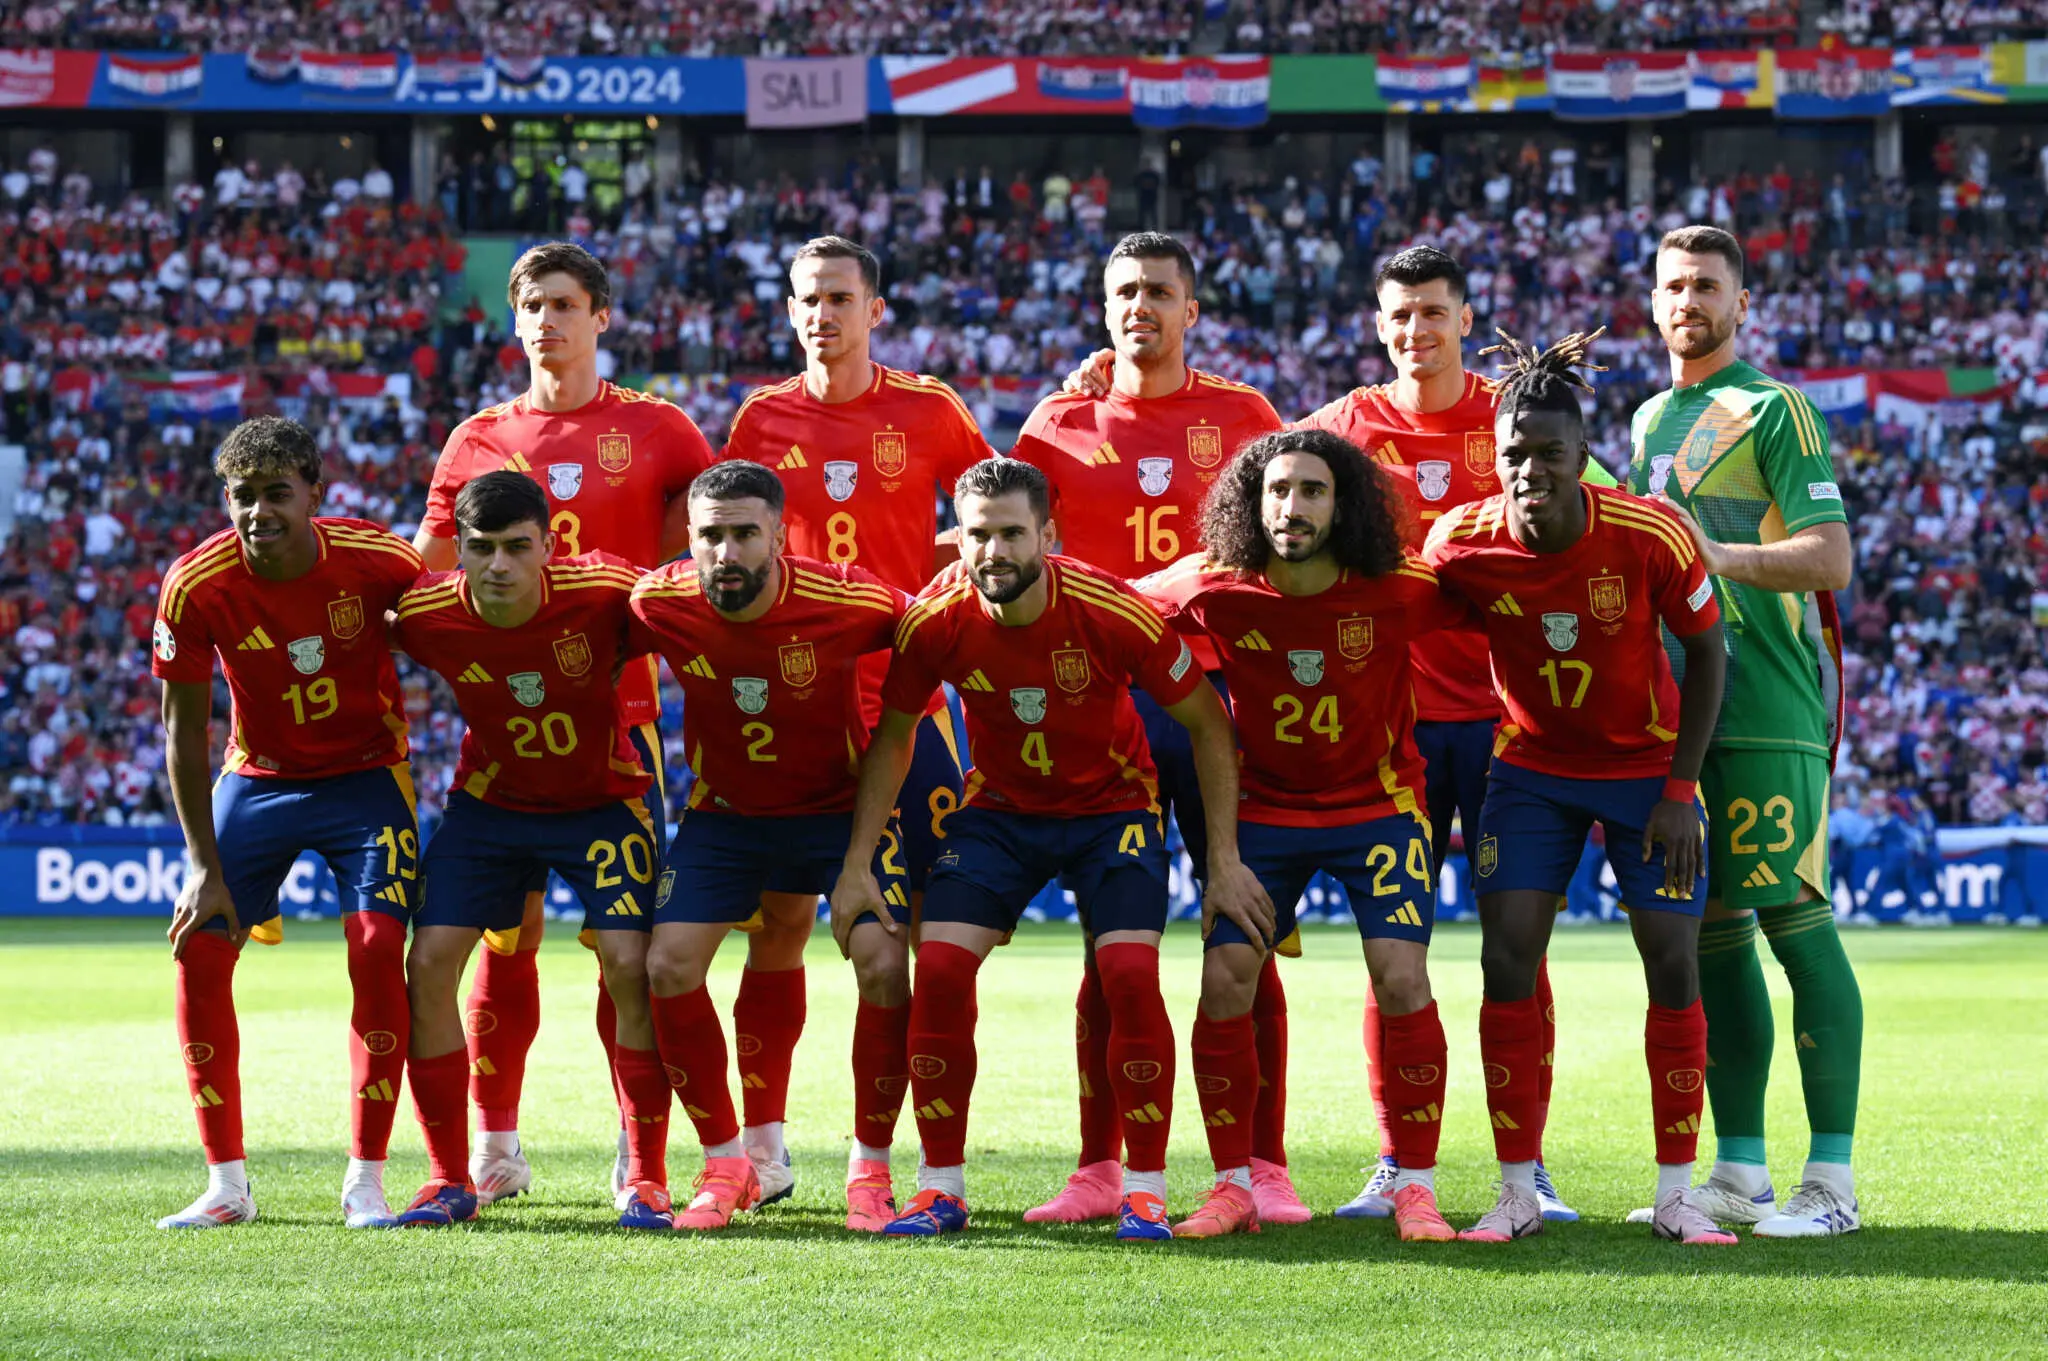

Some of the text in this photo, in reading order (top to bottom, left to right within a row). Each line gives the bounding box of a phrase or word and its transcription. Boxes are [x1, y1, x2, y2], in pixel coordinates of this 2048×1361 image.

[576, 66, 683, 104] 2024
[762, 69, 842, 112] SALI
[826, 511, 859, 564] 8
[1126, 505, 1180, 562] 16
[282, 677, 339, 725] 19
[1538, 659, 1593, 708] 17
[506, 711, 578, 758] 20
[741, 721, 778, 762] 2
[1273, 694, 1343, 744] 24
[1020, 731, 1054, 776] 4
[1727, 794, 1795, 855] 23
[376, 826, 417, 880] 19
[586, 833, 653, 889] 20
[1365, 838, 1431, 897] 24
